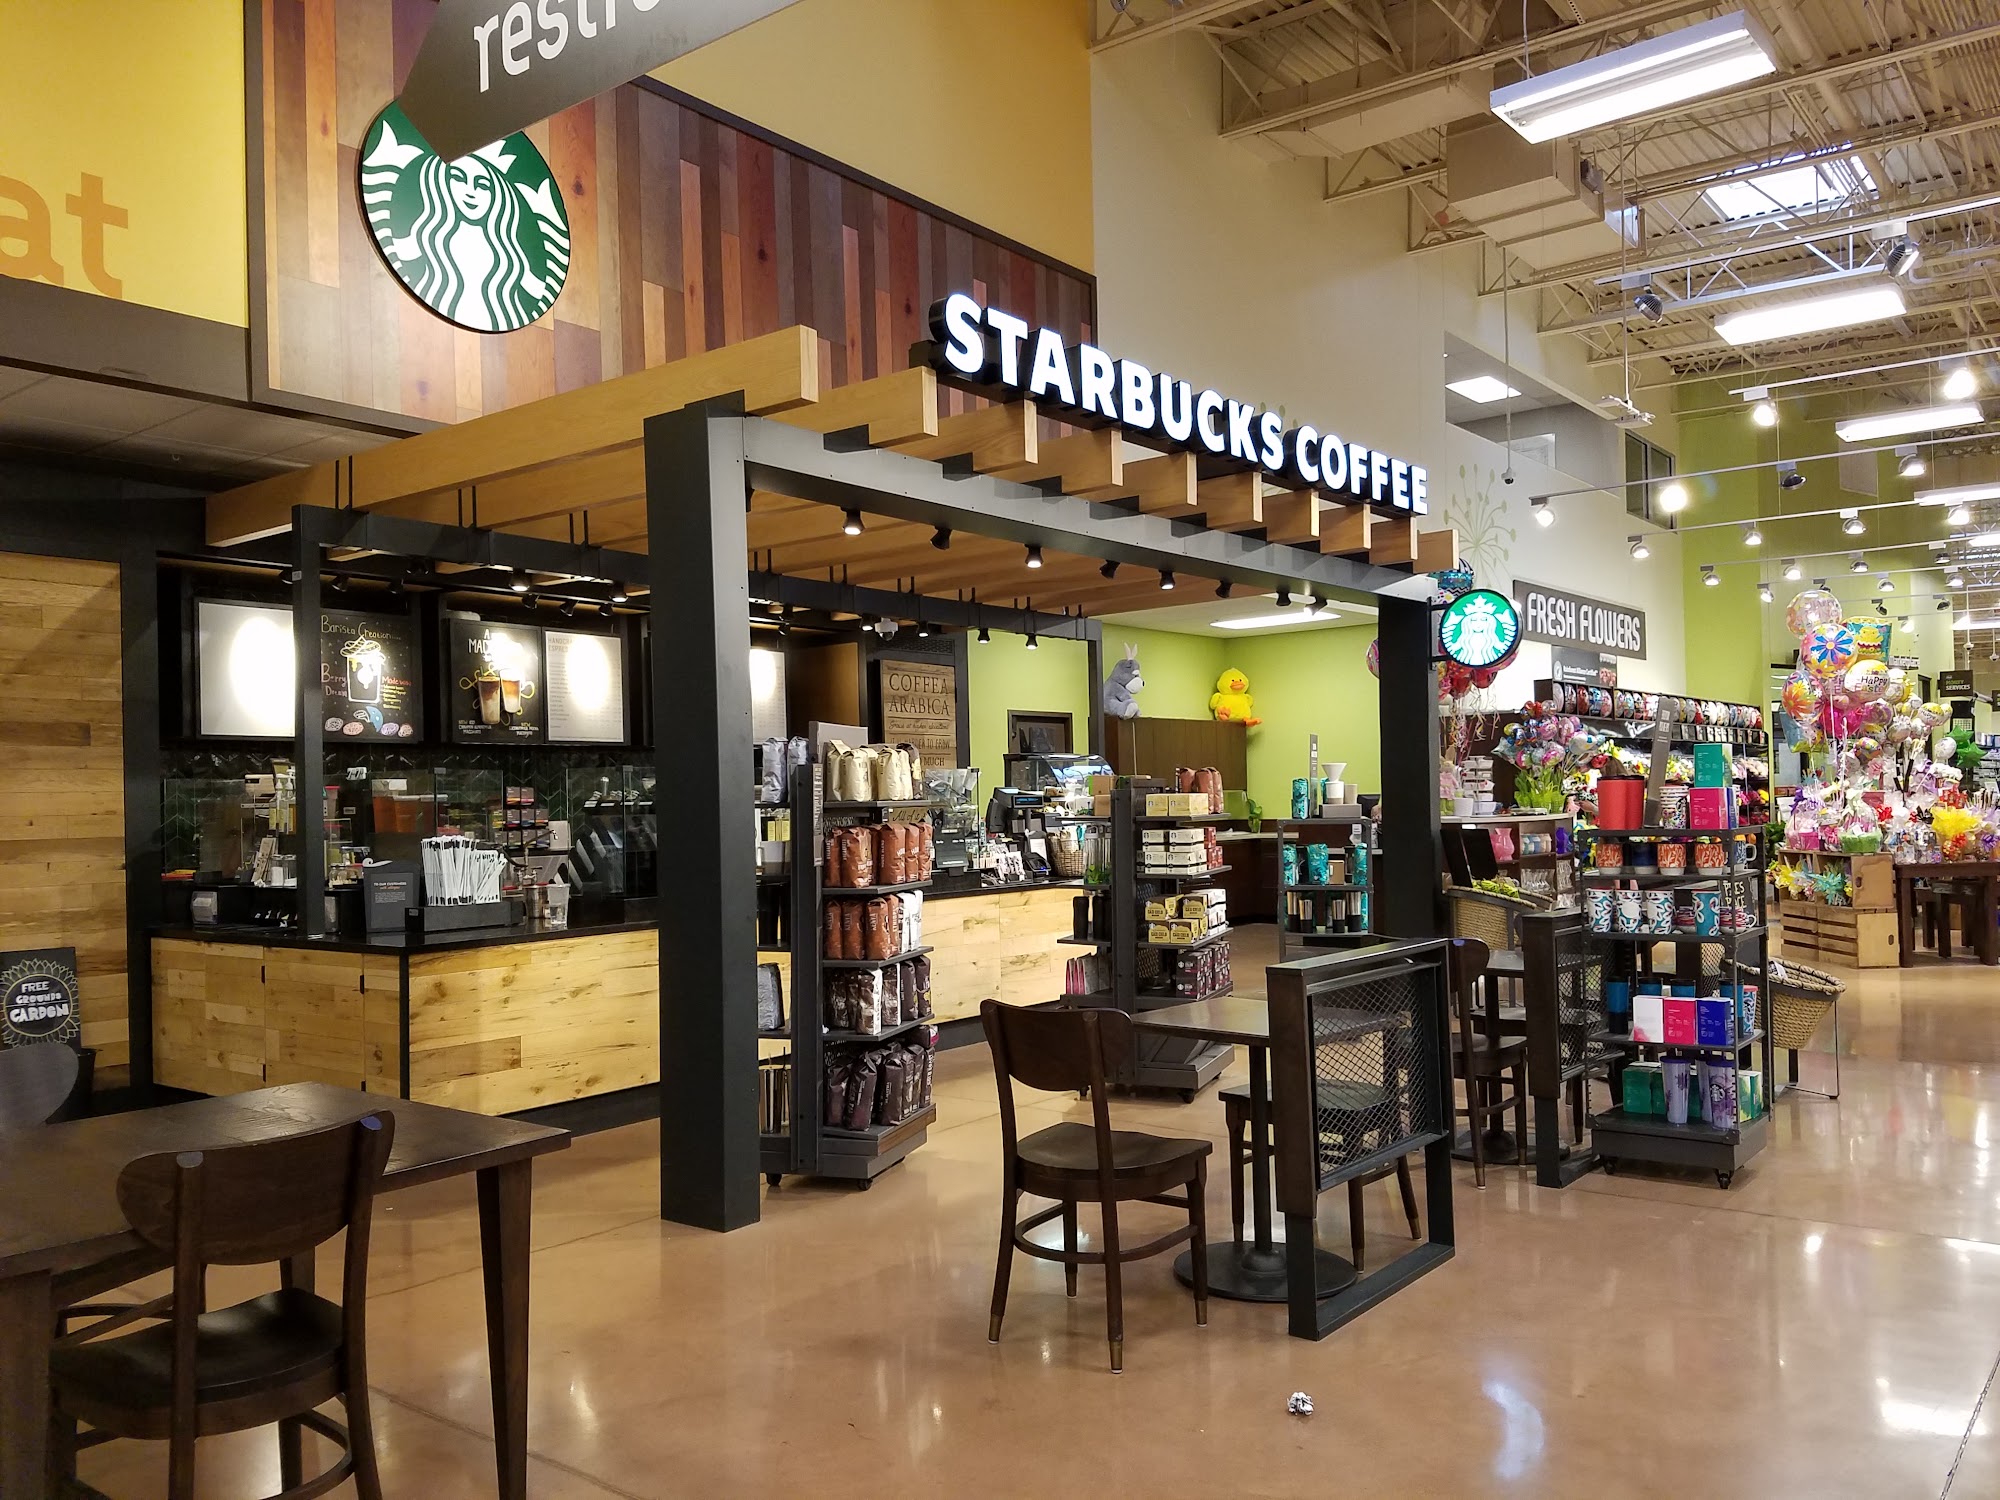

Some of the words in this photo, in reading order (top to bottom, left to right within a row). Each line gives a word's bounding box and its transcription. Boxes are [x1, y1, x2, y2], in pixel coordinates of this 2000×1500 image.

[943, 292, 1284, 471] STARBUCKS
[1294, 424, 1429, 516] COFFEE
[321, 615, 356, 635] Barista
[1526, 591, 1577, 640] FRESH
[1579, 604, 1641, 652] FLOWERS
[321, 662, 347, 688] Berry
[889, 673, 949, 695] COFFEA
[889, 695, 951, 716] ARABICA
[923, 757, 945, 767] MUCH
[21, 981, 50, 993] FREE
[15, 993, 62, 1003] GROUNDS
